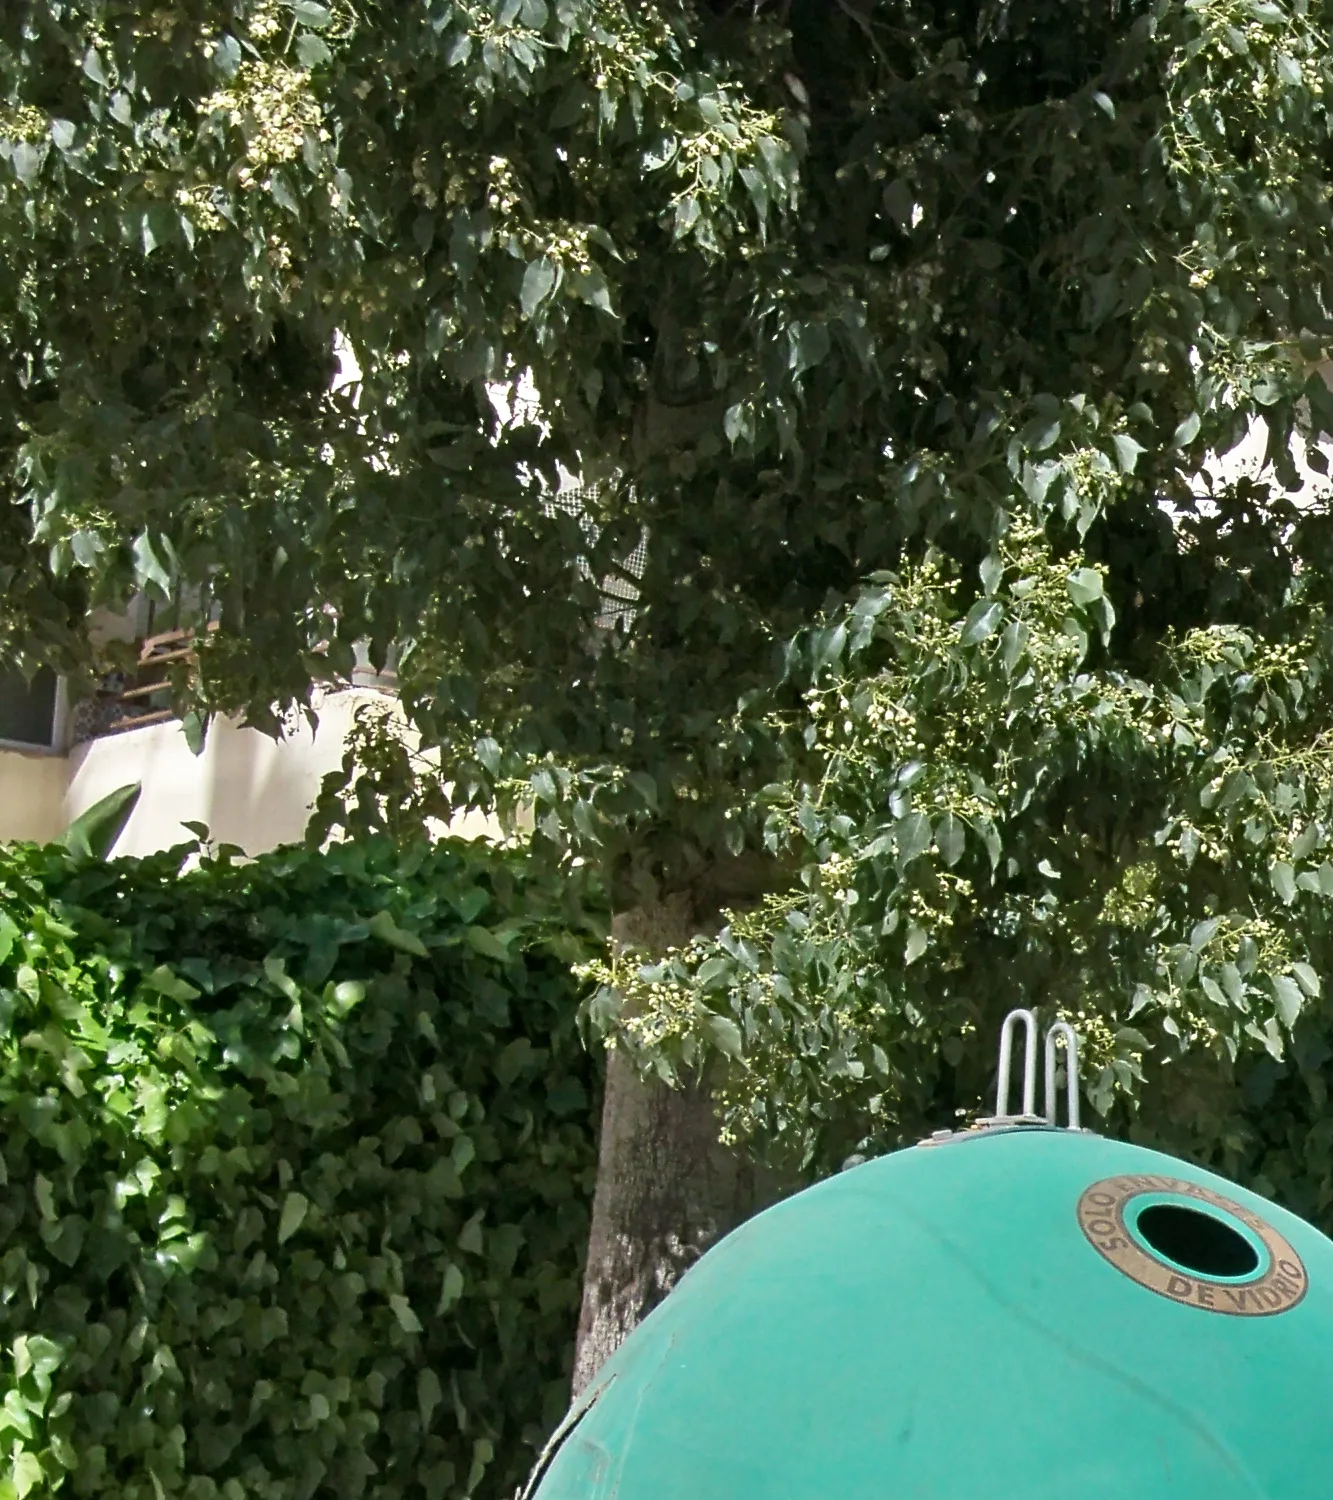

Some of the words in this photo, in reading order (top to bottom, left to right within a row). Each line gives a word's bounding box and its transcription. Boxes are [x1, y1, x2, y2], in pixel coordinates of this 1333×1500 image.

[1085, 1192, 1129, 1251] SOLO
[1167, 1274, 1215, 1307] DE
[1222, 1259, 1304, 1311] VIDRIO
